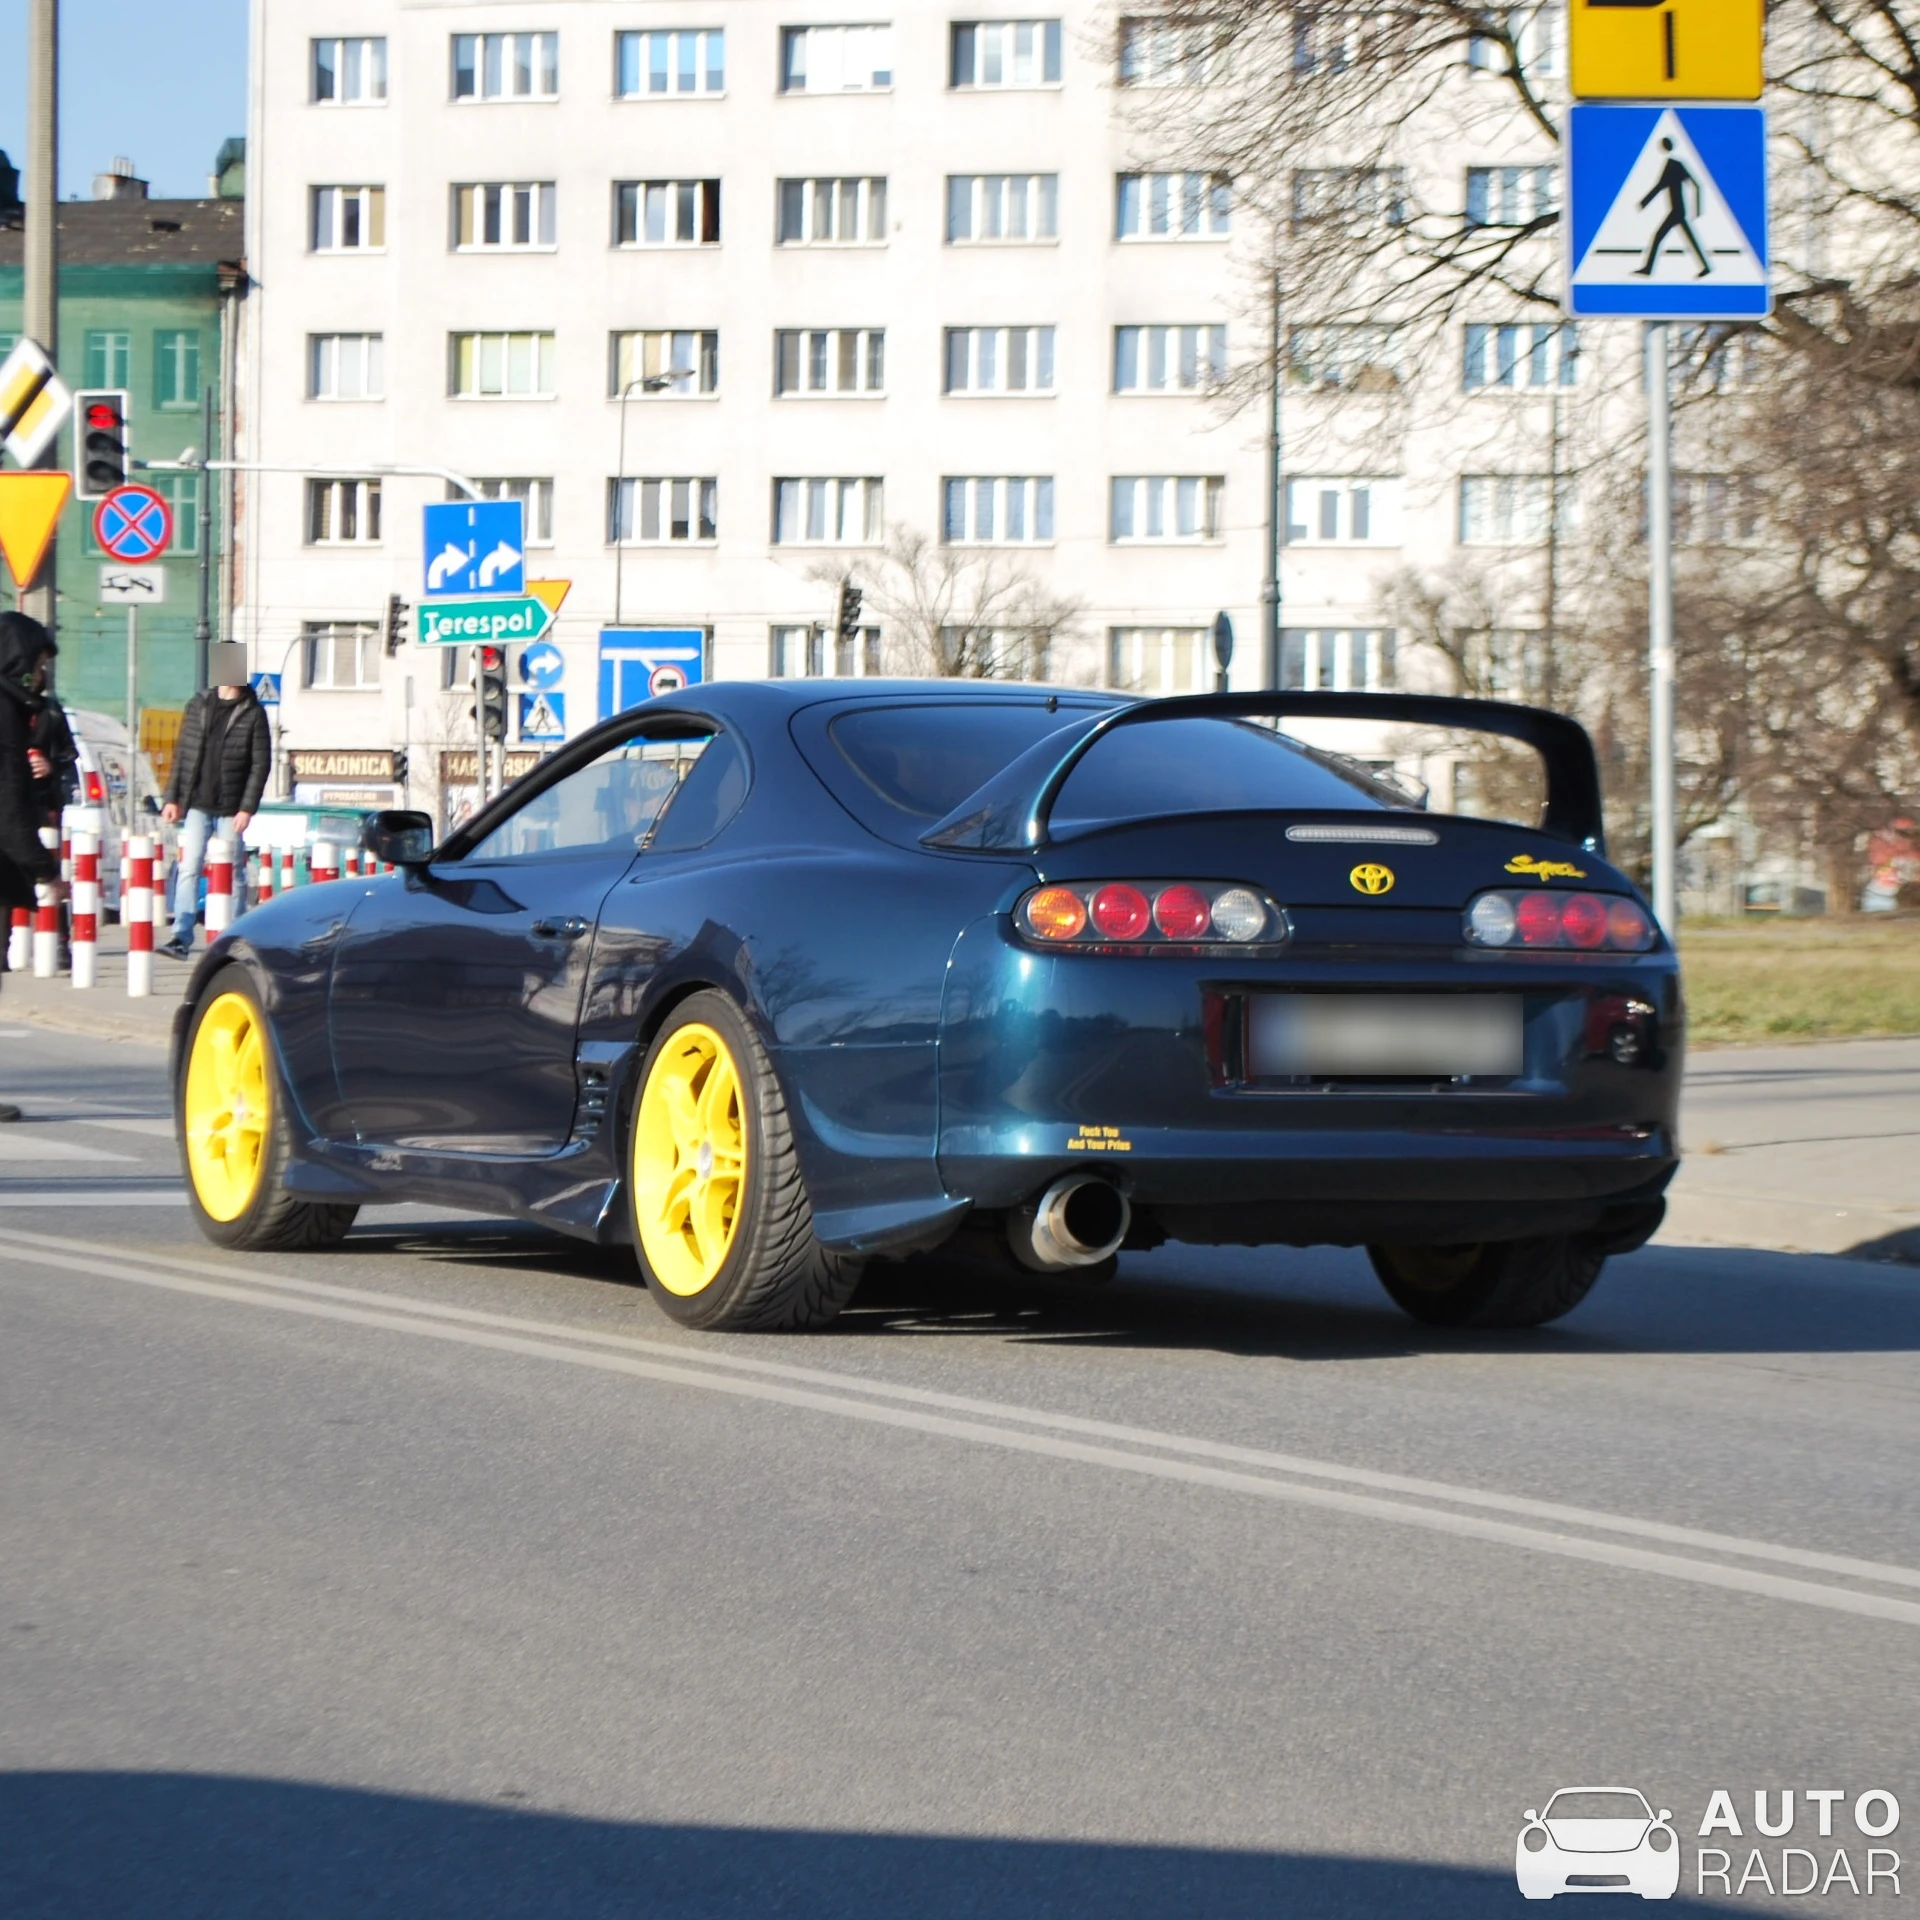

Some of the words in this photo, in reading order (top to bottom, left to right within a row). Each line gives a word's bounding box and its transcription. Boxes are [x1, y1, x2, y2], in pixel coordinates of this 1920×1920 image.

[424, 606, 532, 639] Terespol
[294, 754, 390, 776] SKŁADNICA
[447, 756, 537, 777] HARRSK
[1504, 854, 1588, 881] Supra
[1102, 1126, 1119, 1138] You
[1067, 1138, 1085, 1150] And
[1086, 1138, 1106, 1150] Your
[1107, 1139, 1132, 1151] Prius
